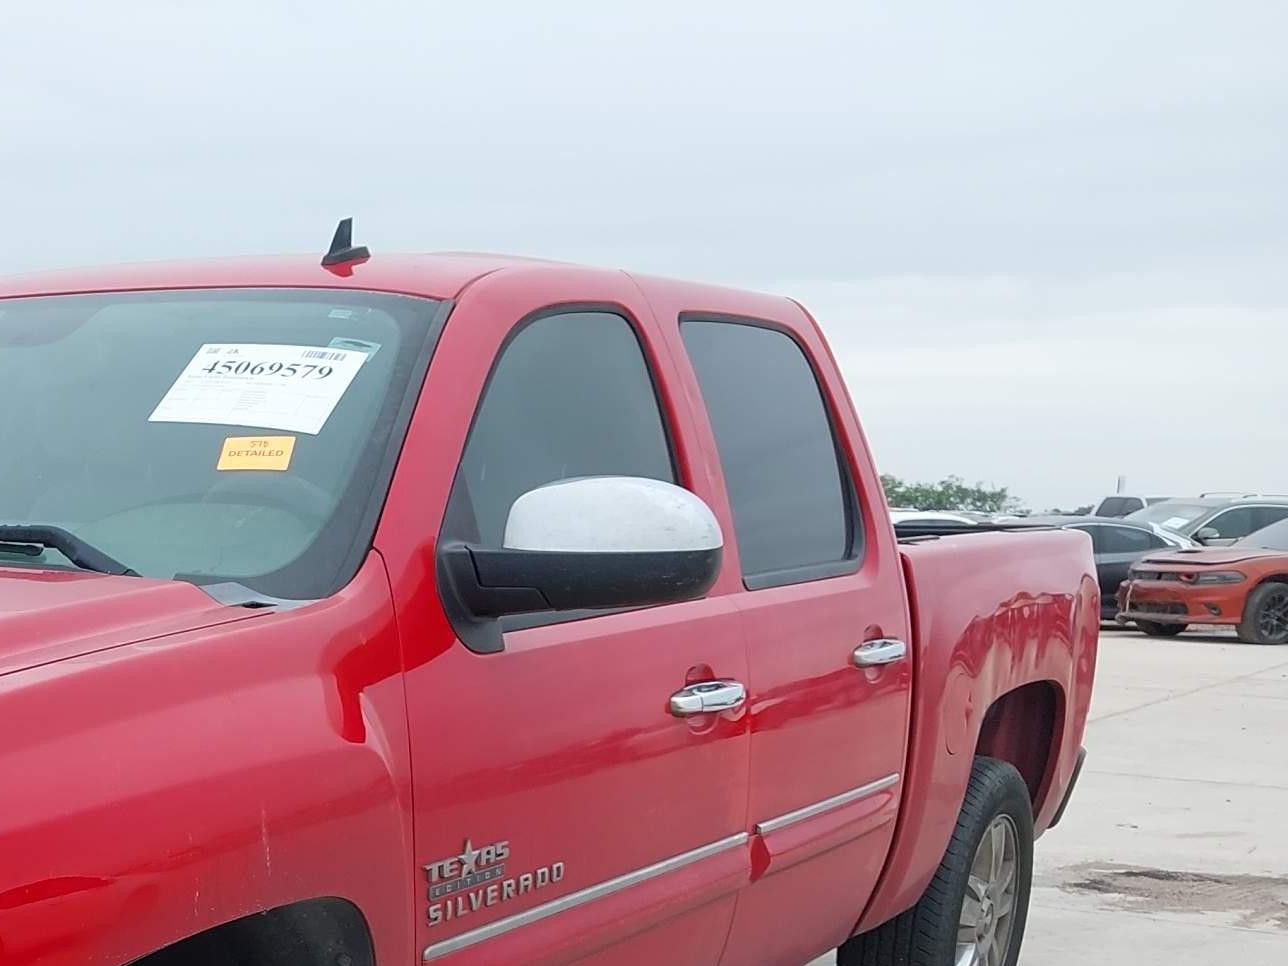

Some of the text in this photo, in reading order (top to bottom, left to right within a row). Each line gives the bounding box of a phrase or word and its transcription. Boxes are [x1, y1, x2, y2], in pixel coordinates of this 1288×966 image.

[202, 360, 333, 380] 45069579
[227, 449, 285, 458] DETAILED
[423, 839, 510, 883] TEXAS
[426, 861, 565, 927] SILVERADO
